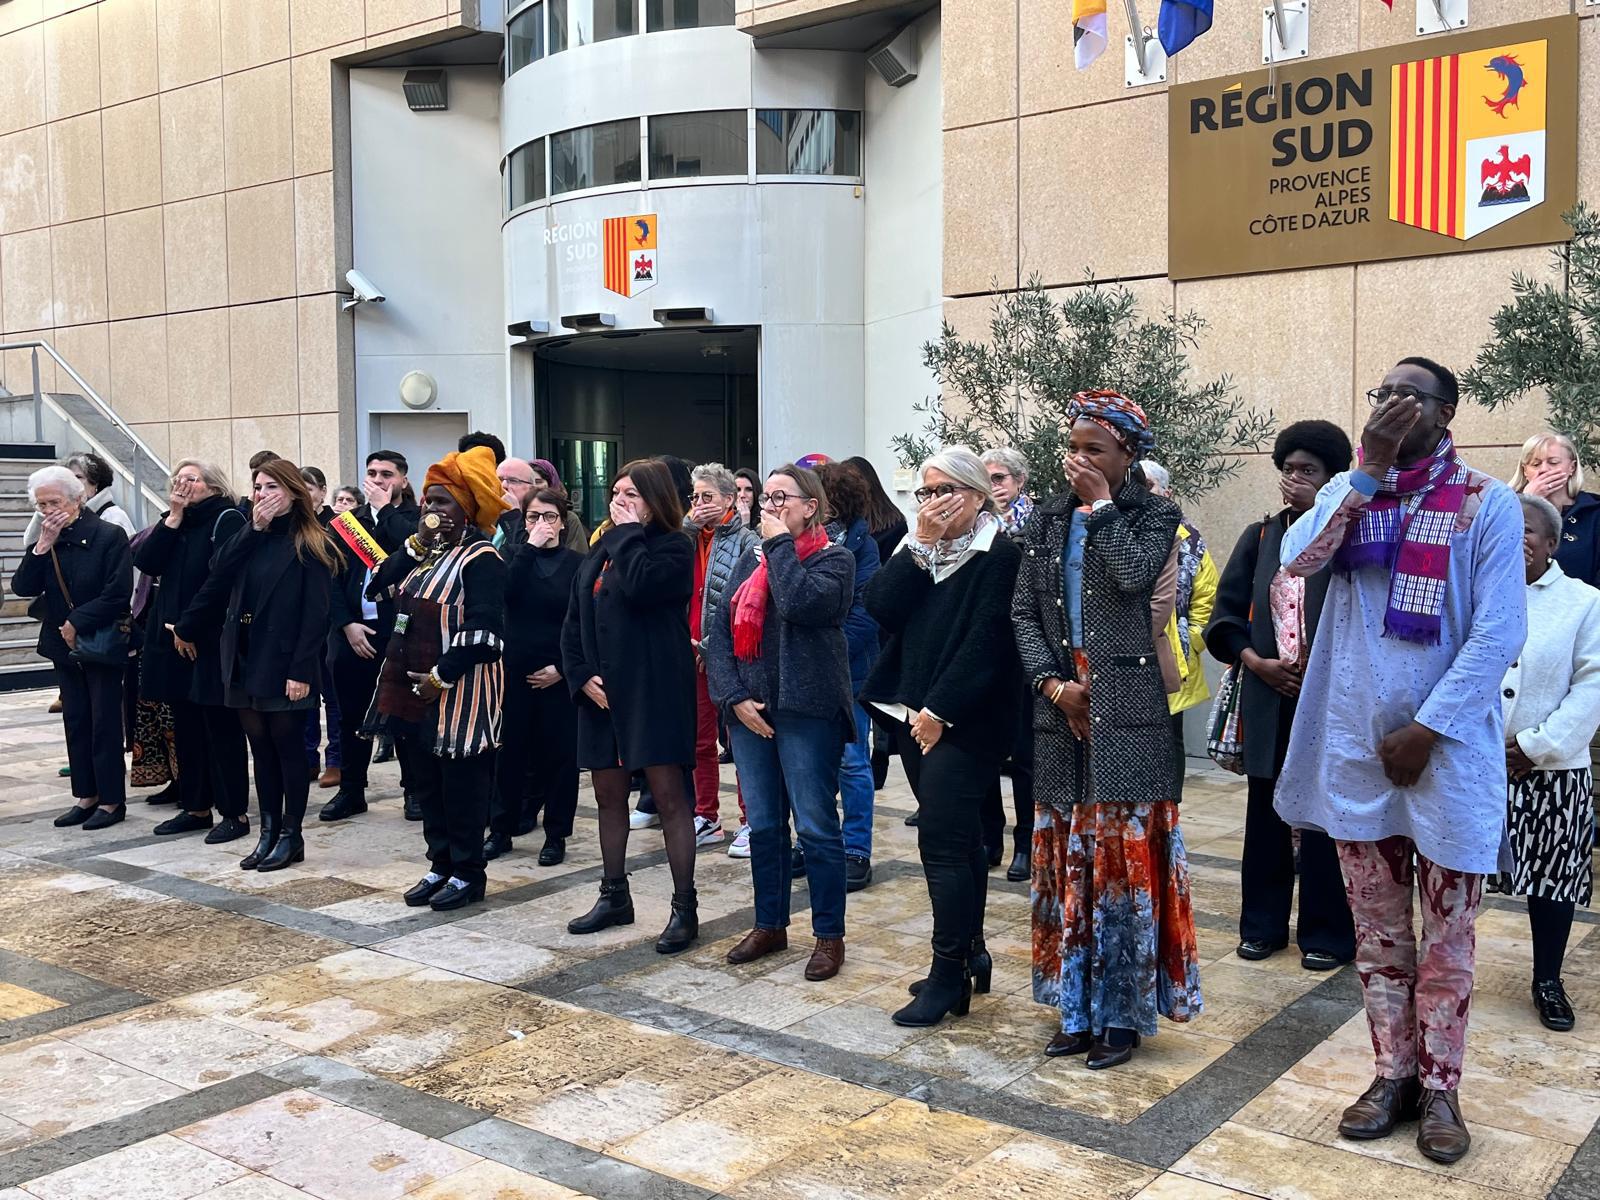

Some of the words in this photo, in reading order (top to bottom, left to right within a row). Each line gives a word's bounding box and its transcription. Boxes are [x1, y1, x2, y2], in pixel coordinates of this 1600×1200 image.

[1190, 68, 1373, 134] RÉGION
[1271, 118, 1373, 167] SUD
[1269, 166, 1371, 195] PROVENCE
[1314, 186, 1371, 209] ALPES
[543, 221, 598, 246] RÉGION
[1249, 214, 1298, 236] CÔTE
[566, 242, 598, 262] SUD
